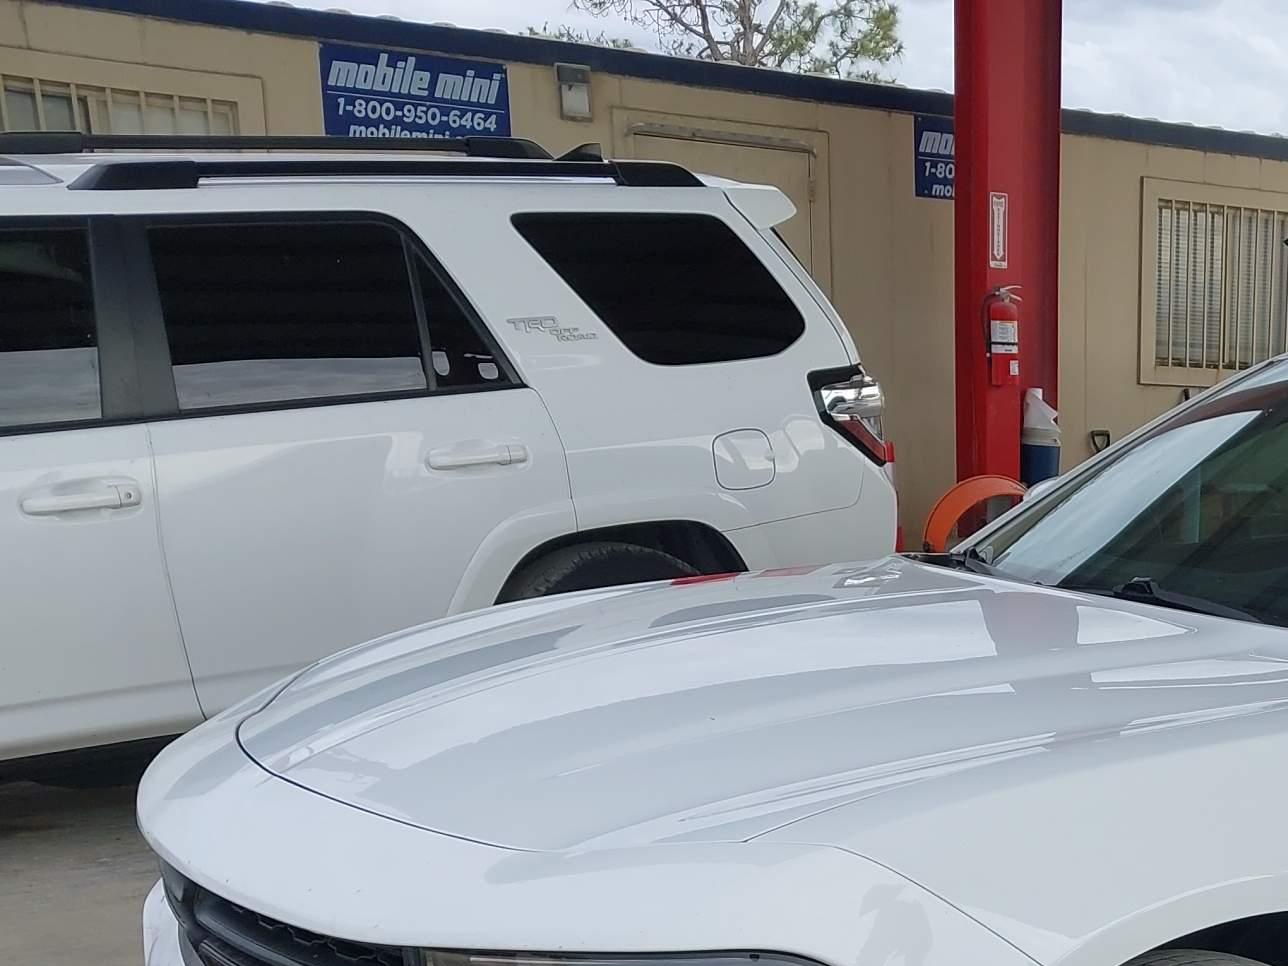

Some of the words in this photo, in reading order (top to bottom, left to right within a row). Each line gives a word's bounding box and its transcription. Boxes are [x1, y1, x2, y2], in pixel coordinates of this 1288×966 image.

[327, 53, 430, 97] mobile
[434, 70, 501, 105] mini
[337, 97, 497, 132] 1-800-950-6464
[506, 315, 557, 333] TRD
